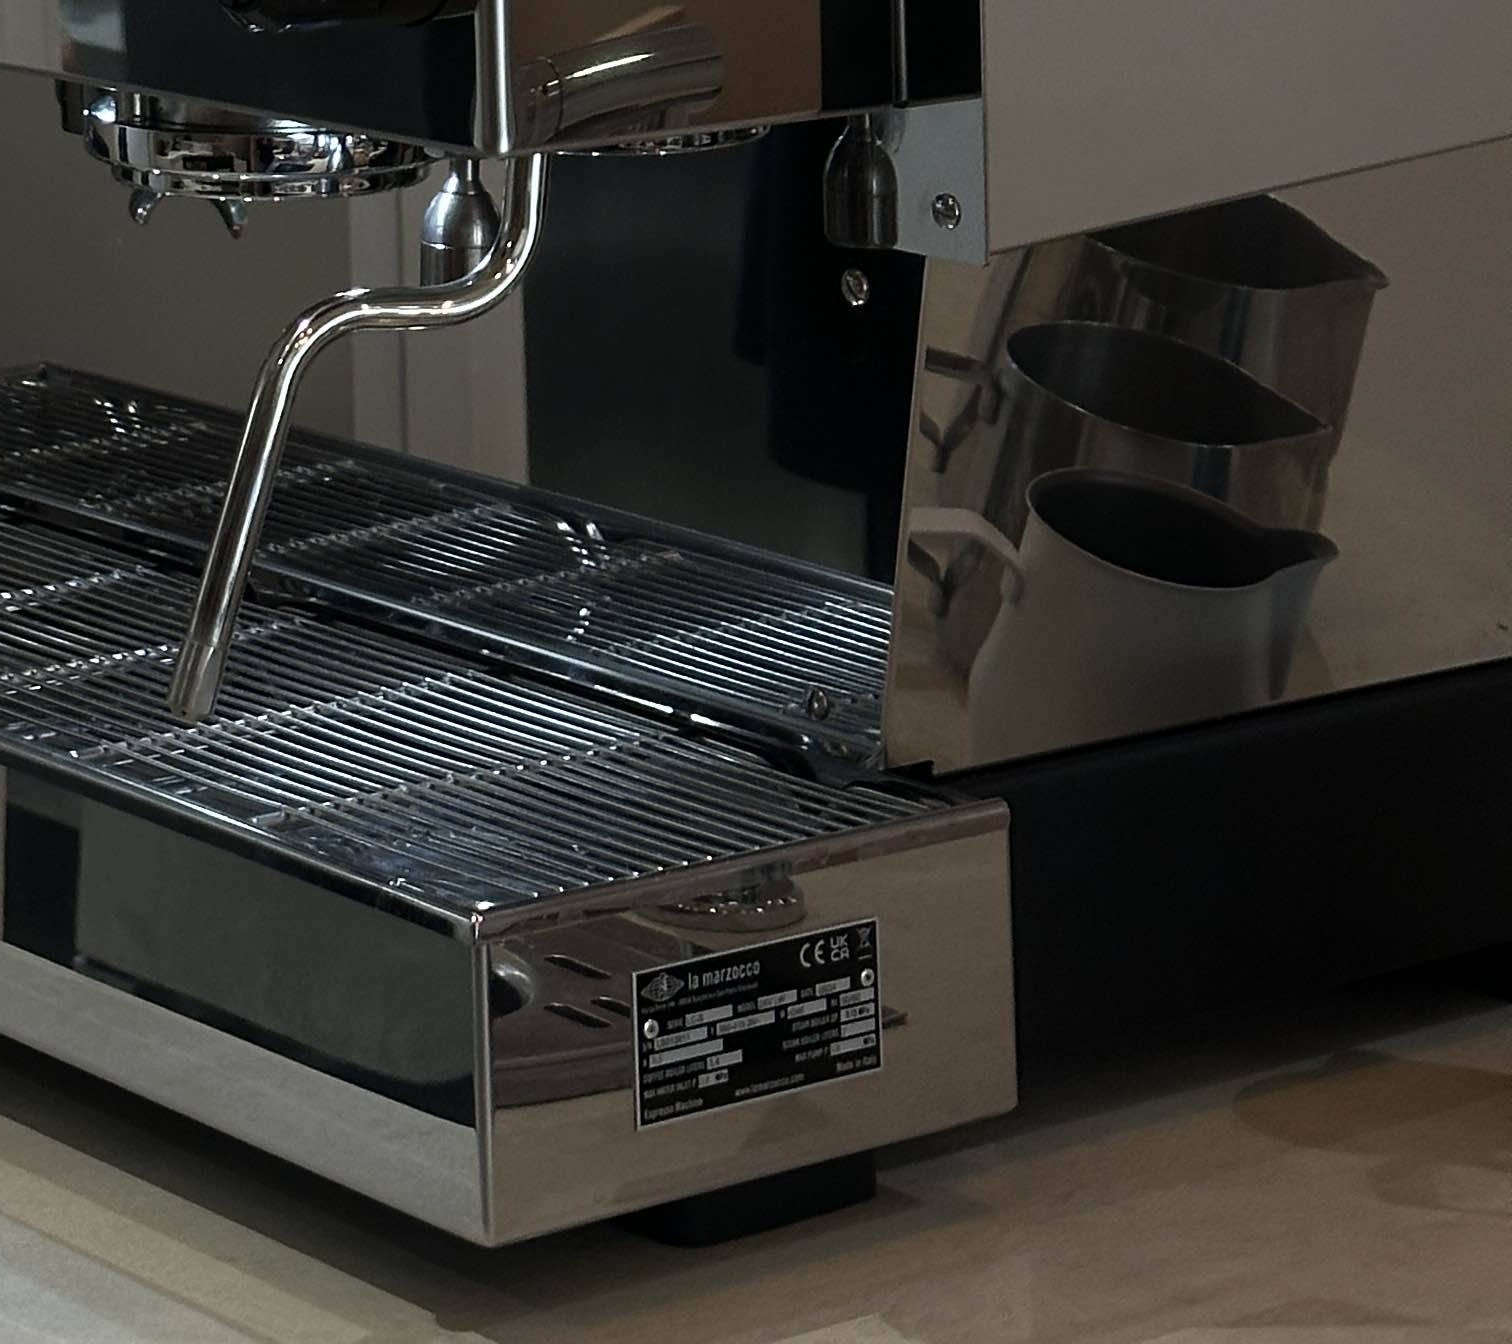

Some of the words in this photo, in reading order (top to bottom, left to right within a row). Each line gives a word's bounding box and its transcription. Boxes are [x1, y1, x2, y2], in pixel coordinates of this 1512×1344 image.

[830, 933, 849, 949] UK
[800, 939, 826, 968] CE
[830, 947, 851, 962] CA
[688, 973, 699, 991] la
[702, 960, 761, 988] marzocco
